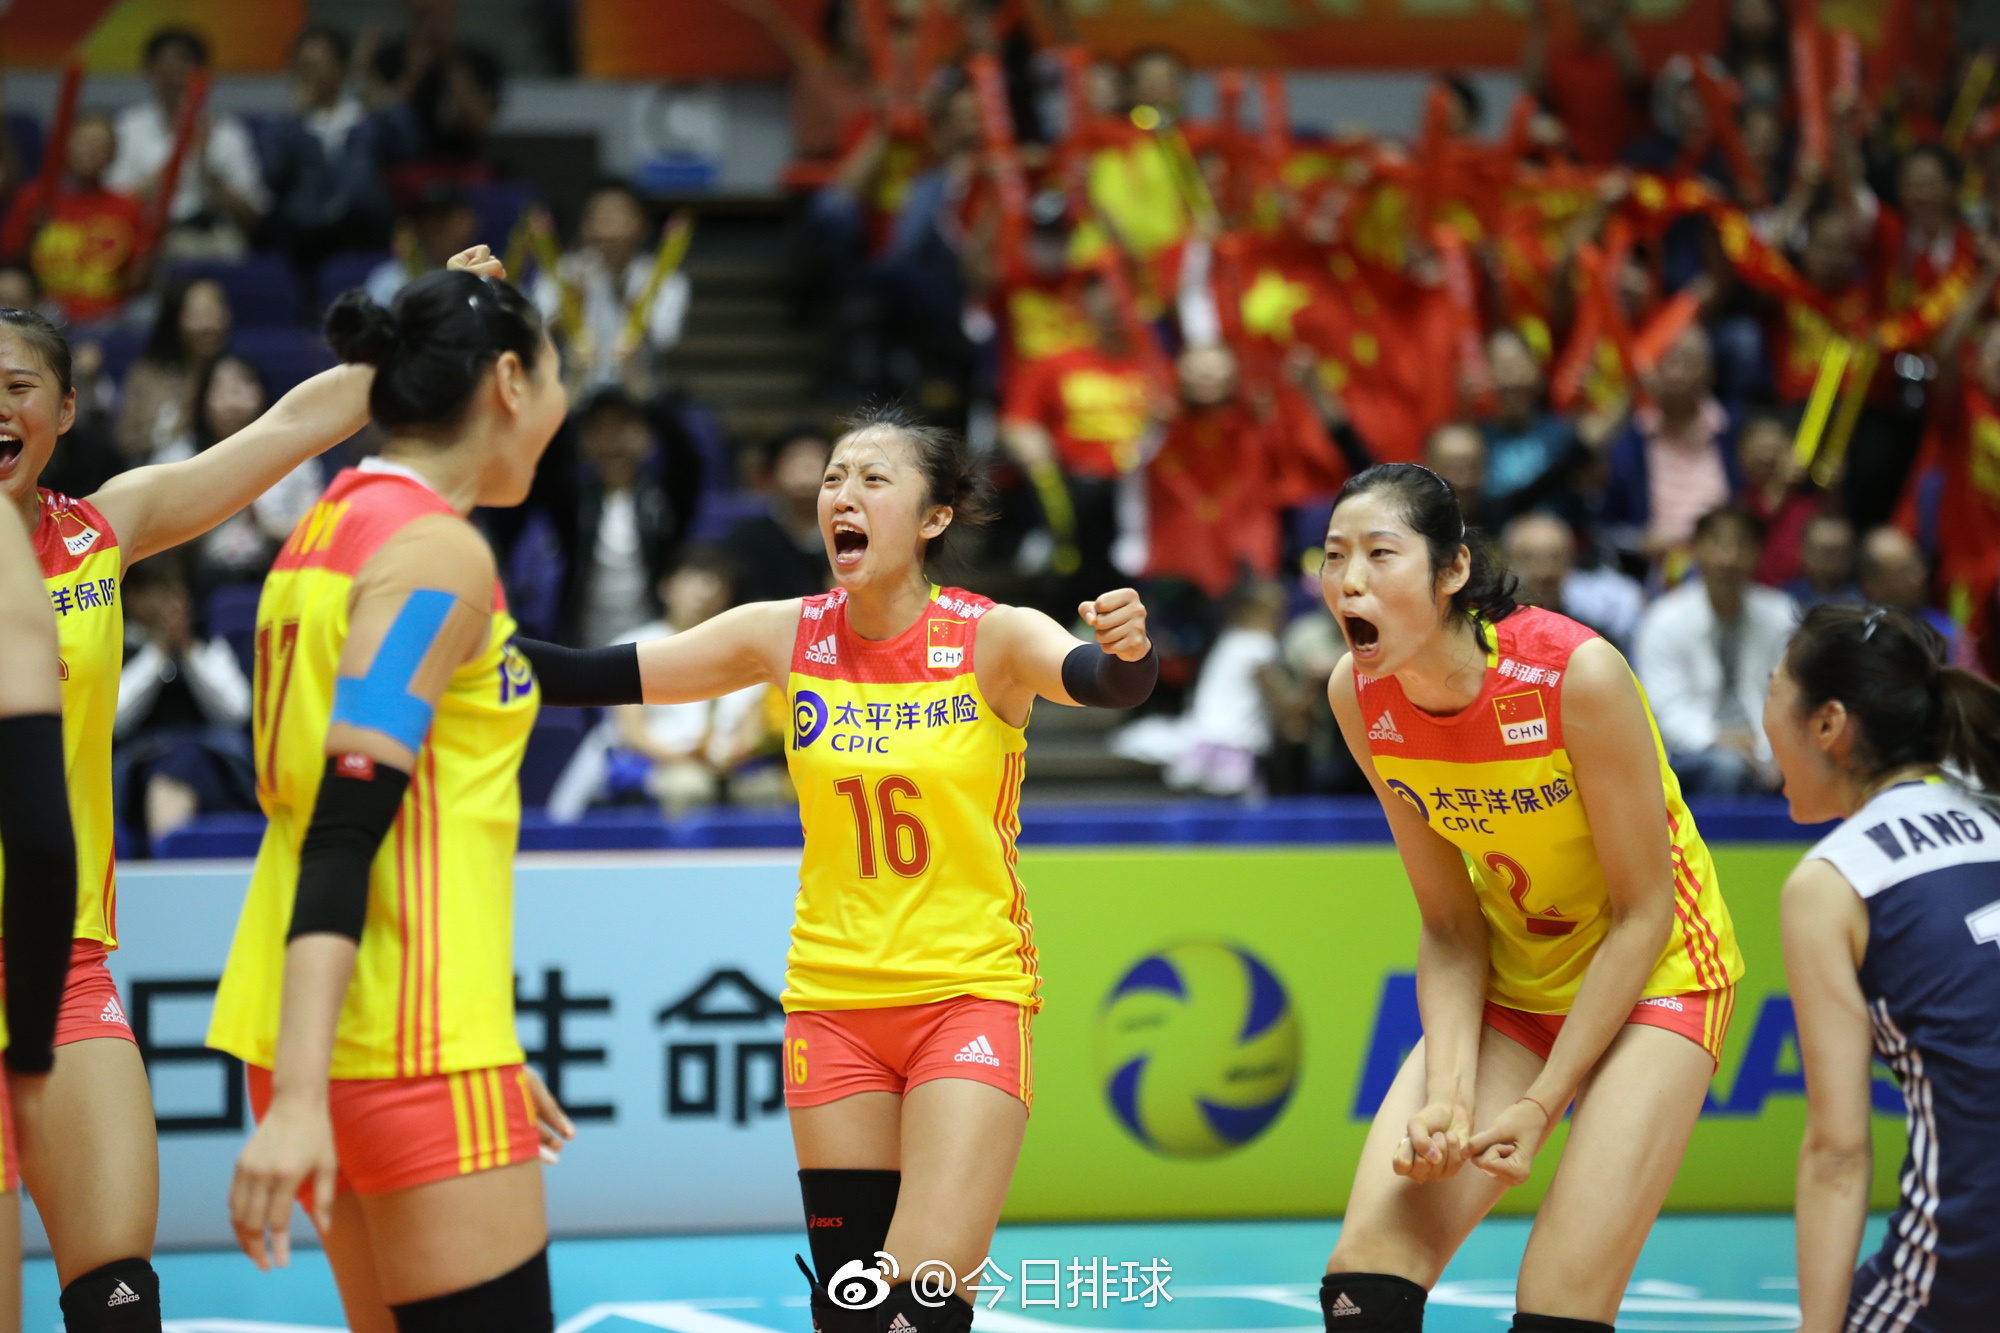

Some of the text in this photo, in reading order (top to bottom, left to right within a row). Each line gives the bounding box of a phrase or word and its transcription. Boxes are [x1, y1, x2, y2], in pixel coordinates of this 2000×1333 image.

[66, 532, 93, 552] CHN
[935, 594, 987, 619] 腾讯新闻
[804, 650, 837, 665] adida
[1497, 658, 1562, 689] 腾讯新闻
[833, 693, 979, 731] 太平洋保险
[1368, 728, 1405, 744] adidas
[1507, 723, 1545, 741] CHN
[831, 733, 890, 754] CPIC
[1429, 777, 1574, 815] 太平洋保险
[833, 774, 931, 880] 16
[1442, 816, 1495, 834] CPIC
[1863, 810, 1984, 864] WANG
[1483, 850, 1580, 937] 2
[786, 1037, 809, 1085] 16
[954, 1050, 1000, 1067] adidas
[816, 1217, 844, 1228] asics
[107, 1292, 140, 1307] adidas
